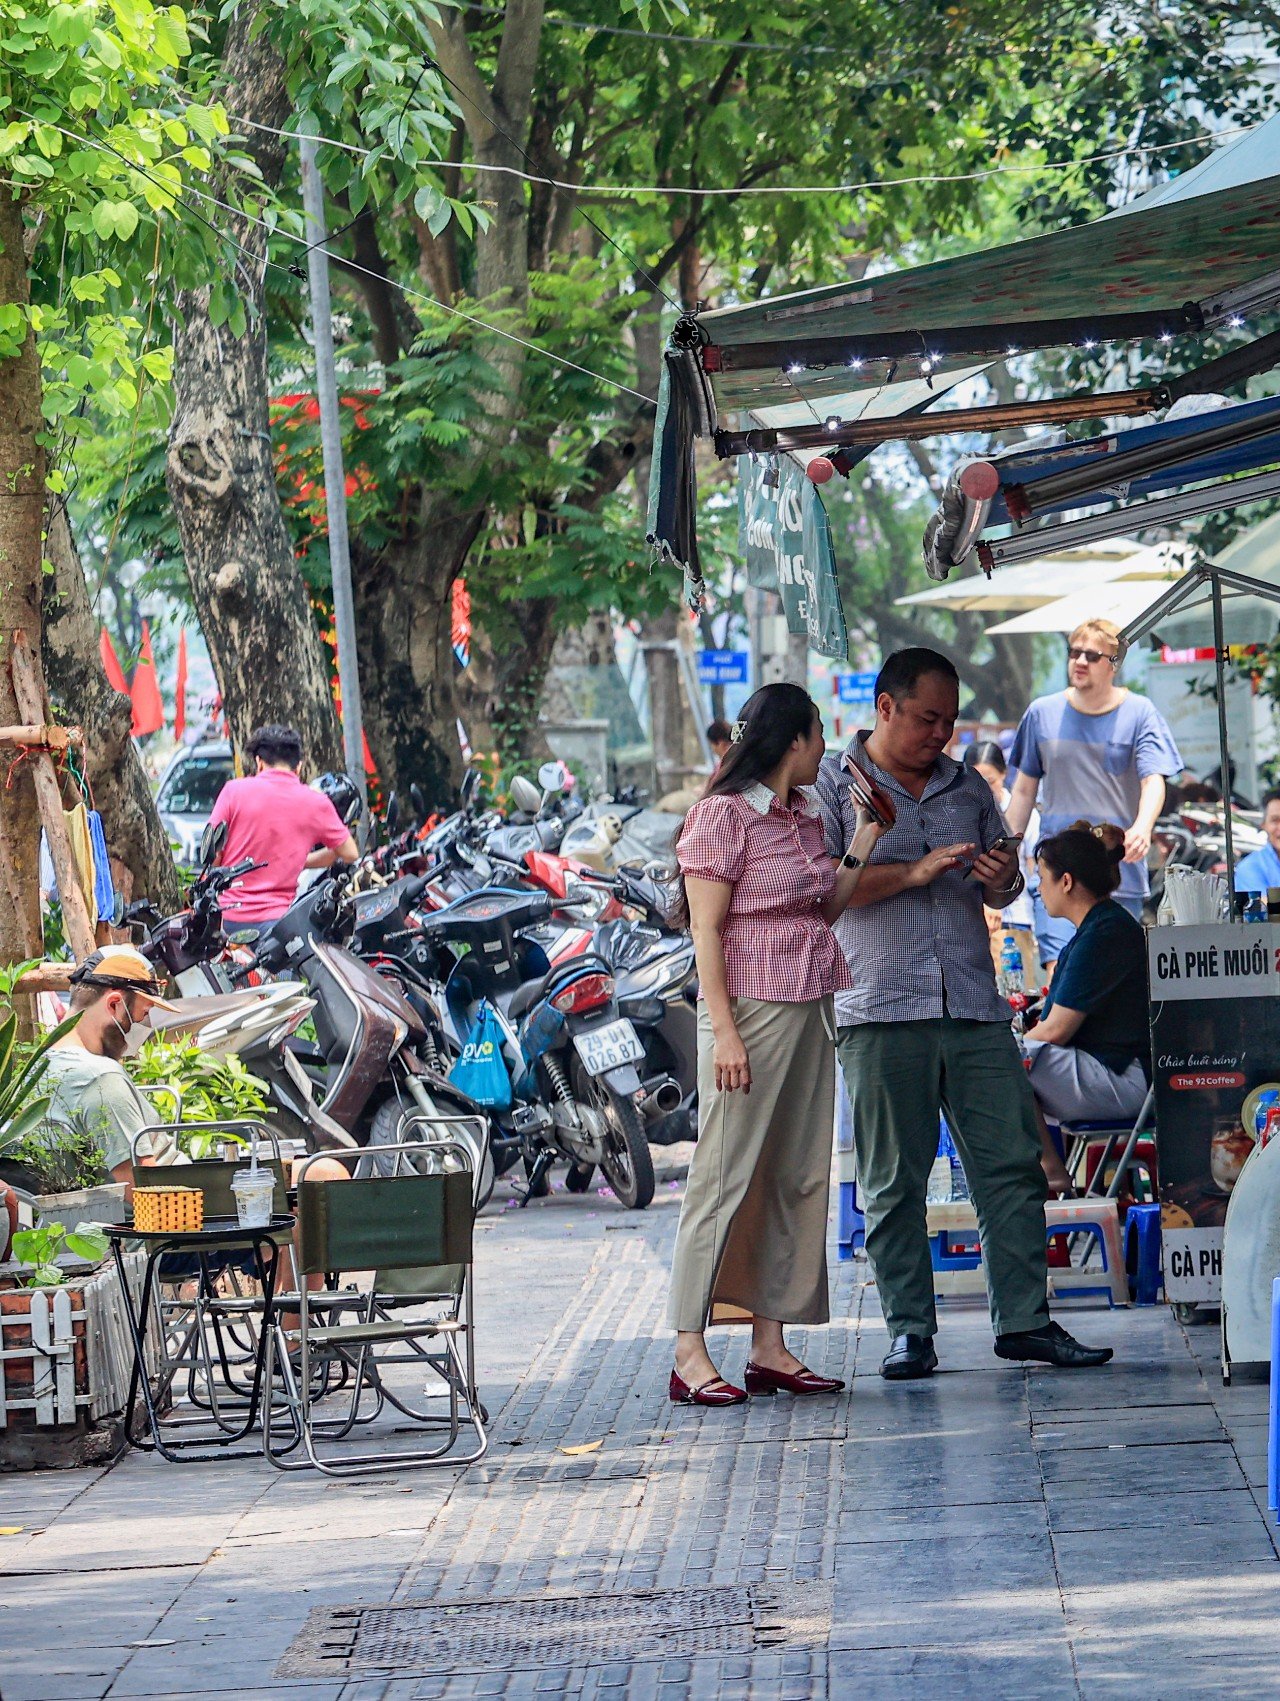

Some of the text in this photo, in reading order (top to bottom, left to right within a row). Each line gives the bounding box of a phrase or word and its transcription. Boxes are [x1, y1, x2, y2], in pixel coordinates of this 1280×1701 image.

[1156, 946, 1182, 981] CÀ
[1185, 945, 1220, 979] PHÊ
[1223, 938, 1270, 976] MUỐI
[587, 1039, 637, 1072] 026.87
[1157, 1054, 1186, 1069] Chào
[1212, 1054, 1238, 1068] sáng
[1177, 1076, 1236, 1087] The 92 Coffee
[1170, 1244, 1196, 1279] CÀ
